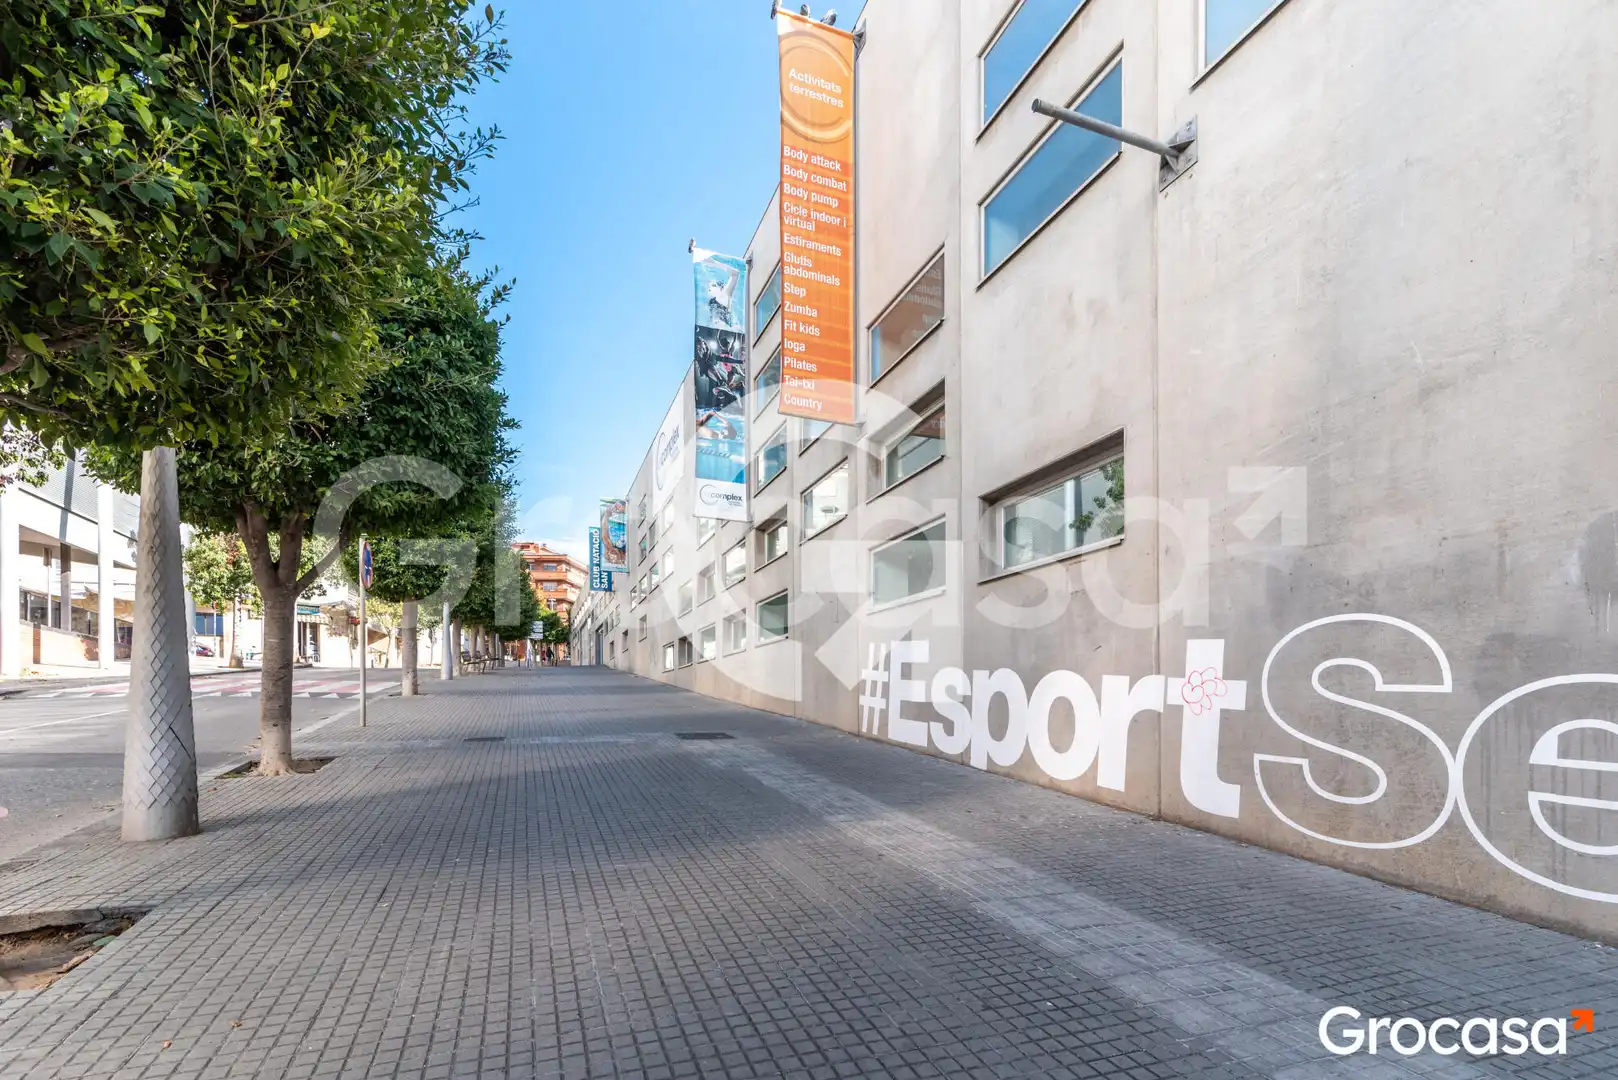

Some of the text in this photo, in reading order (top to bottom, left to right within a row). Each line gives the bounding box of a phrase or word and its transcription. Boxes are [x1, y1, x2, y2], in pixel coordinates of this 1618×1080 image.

[788, 67, 842, 94] Activitats
[788, 82, 844, 108] terrestres
[783, 145, 841, 172] Body attack
[783, 164, 847, 192] Body combat
[783, 182, 839, 209] Body pump
[783, 201, 808, 217] Cicle
[810, 208, 841, 226] indoor
[783, 232, 842, 256] Estiraments
[783, 265, 841, 286] abdominals
[783, 282, 807, 298] Step
[784, 301, 818, 318] Zumba
[784, 319, 820, 336] Fit kids
[784, 338, 806, 353] Ioga
[784, 356, 818, 373] Pilates
[784, 393, 823, 411] Country
